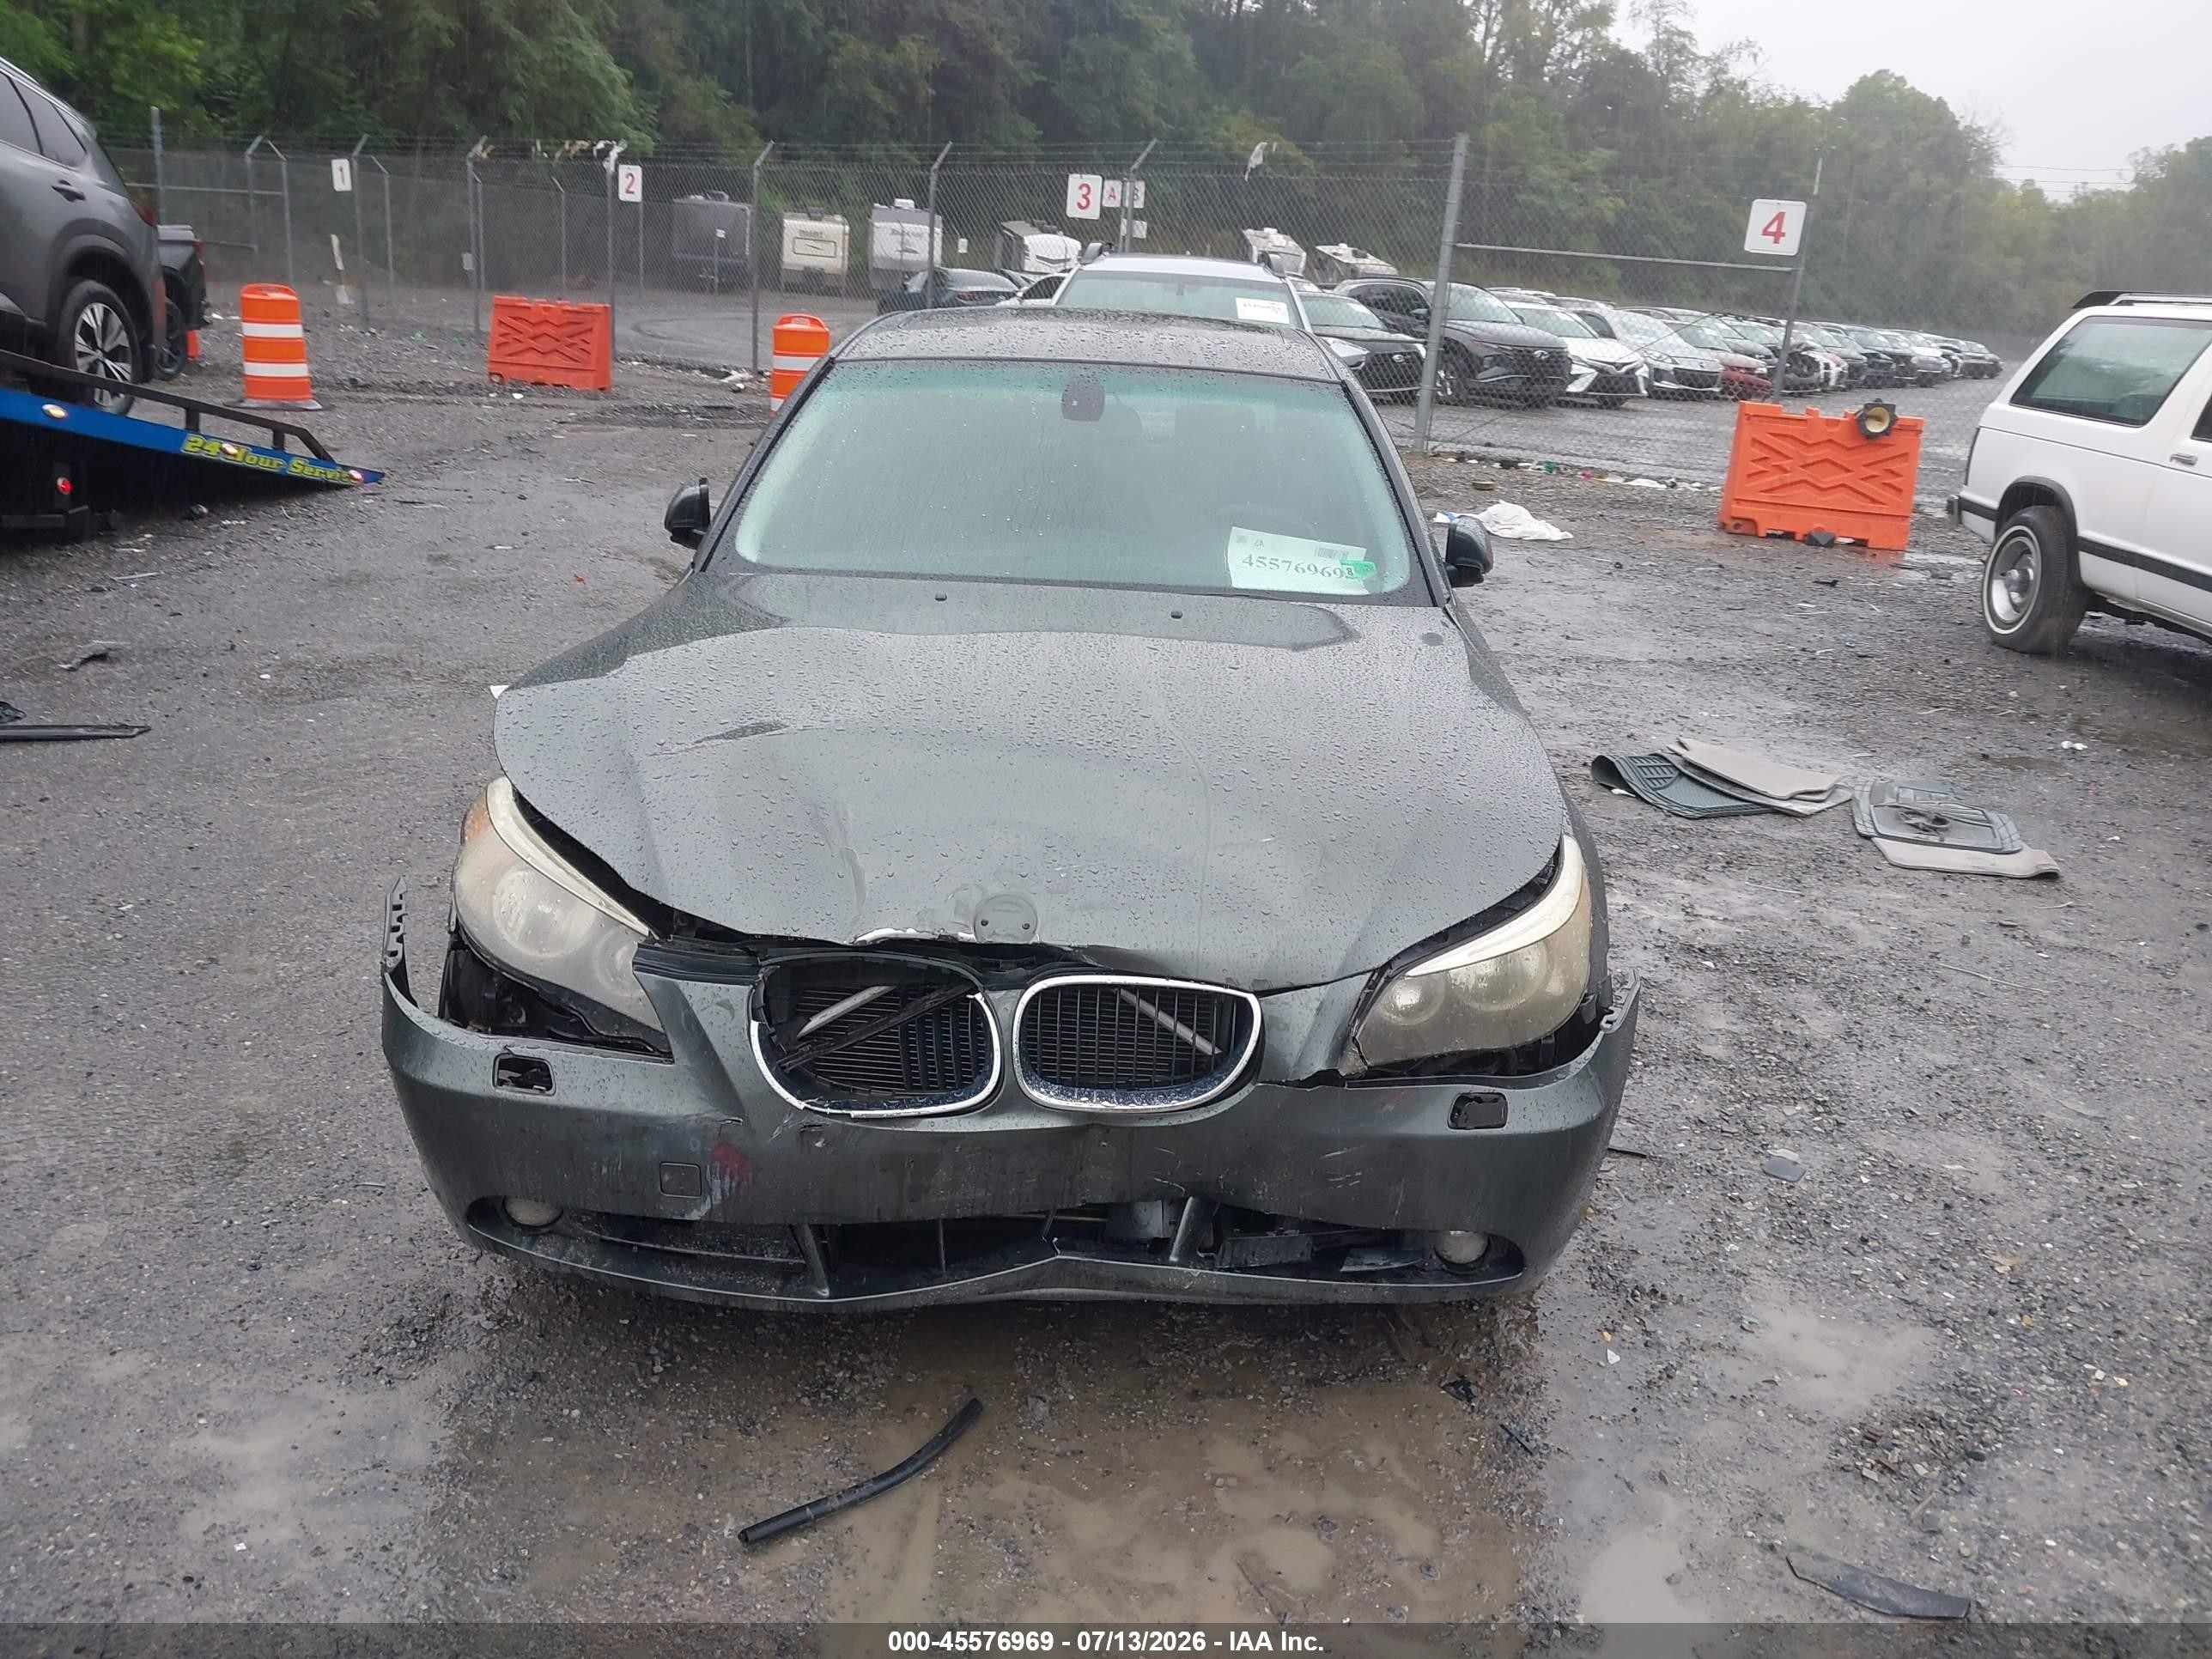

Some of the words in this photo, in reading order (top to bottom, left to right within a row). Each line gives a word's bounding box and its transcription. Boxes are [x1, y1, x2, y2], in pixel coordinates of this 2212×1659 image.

[625, 173, 635, 194] 2
[1109, 187, 1116, 201] A
[1077, 183, 1091, 210] 3
[1761, 211, 1786, 245] 4
[180, 434, 222, 459] 24
